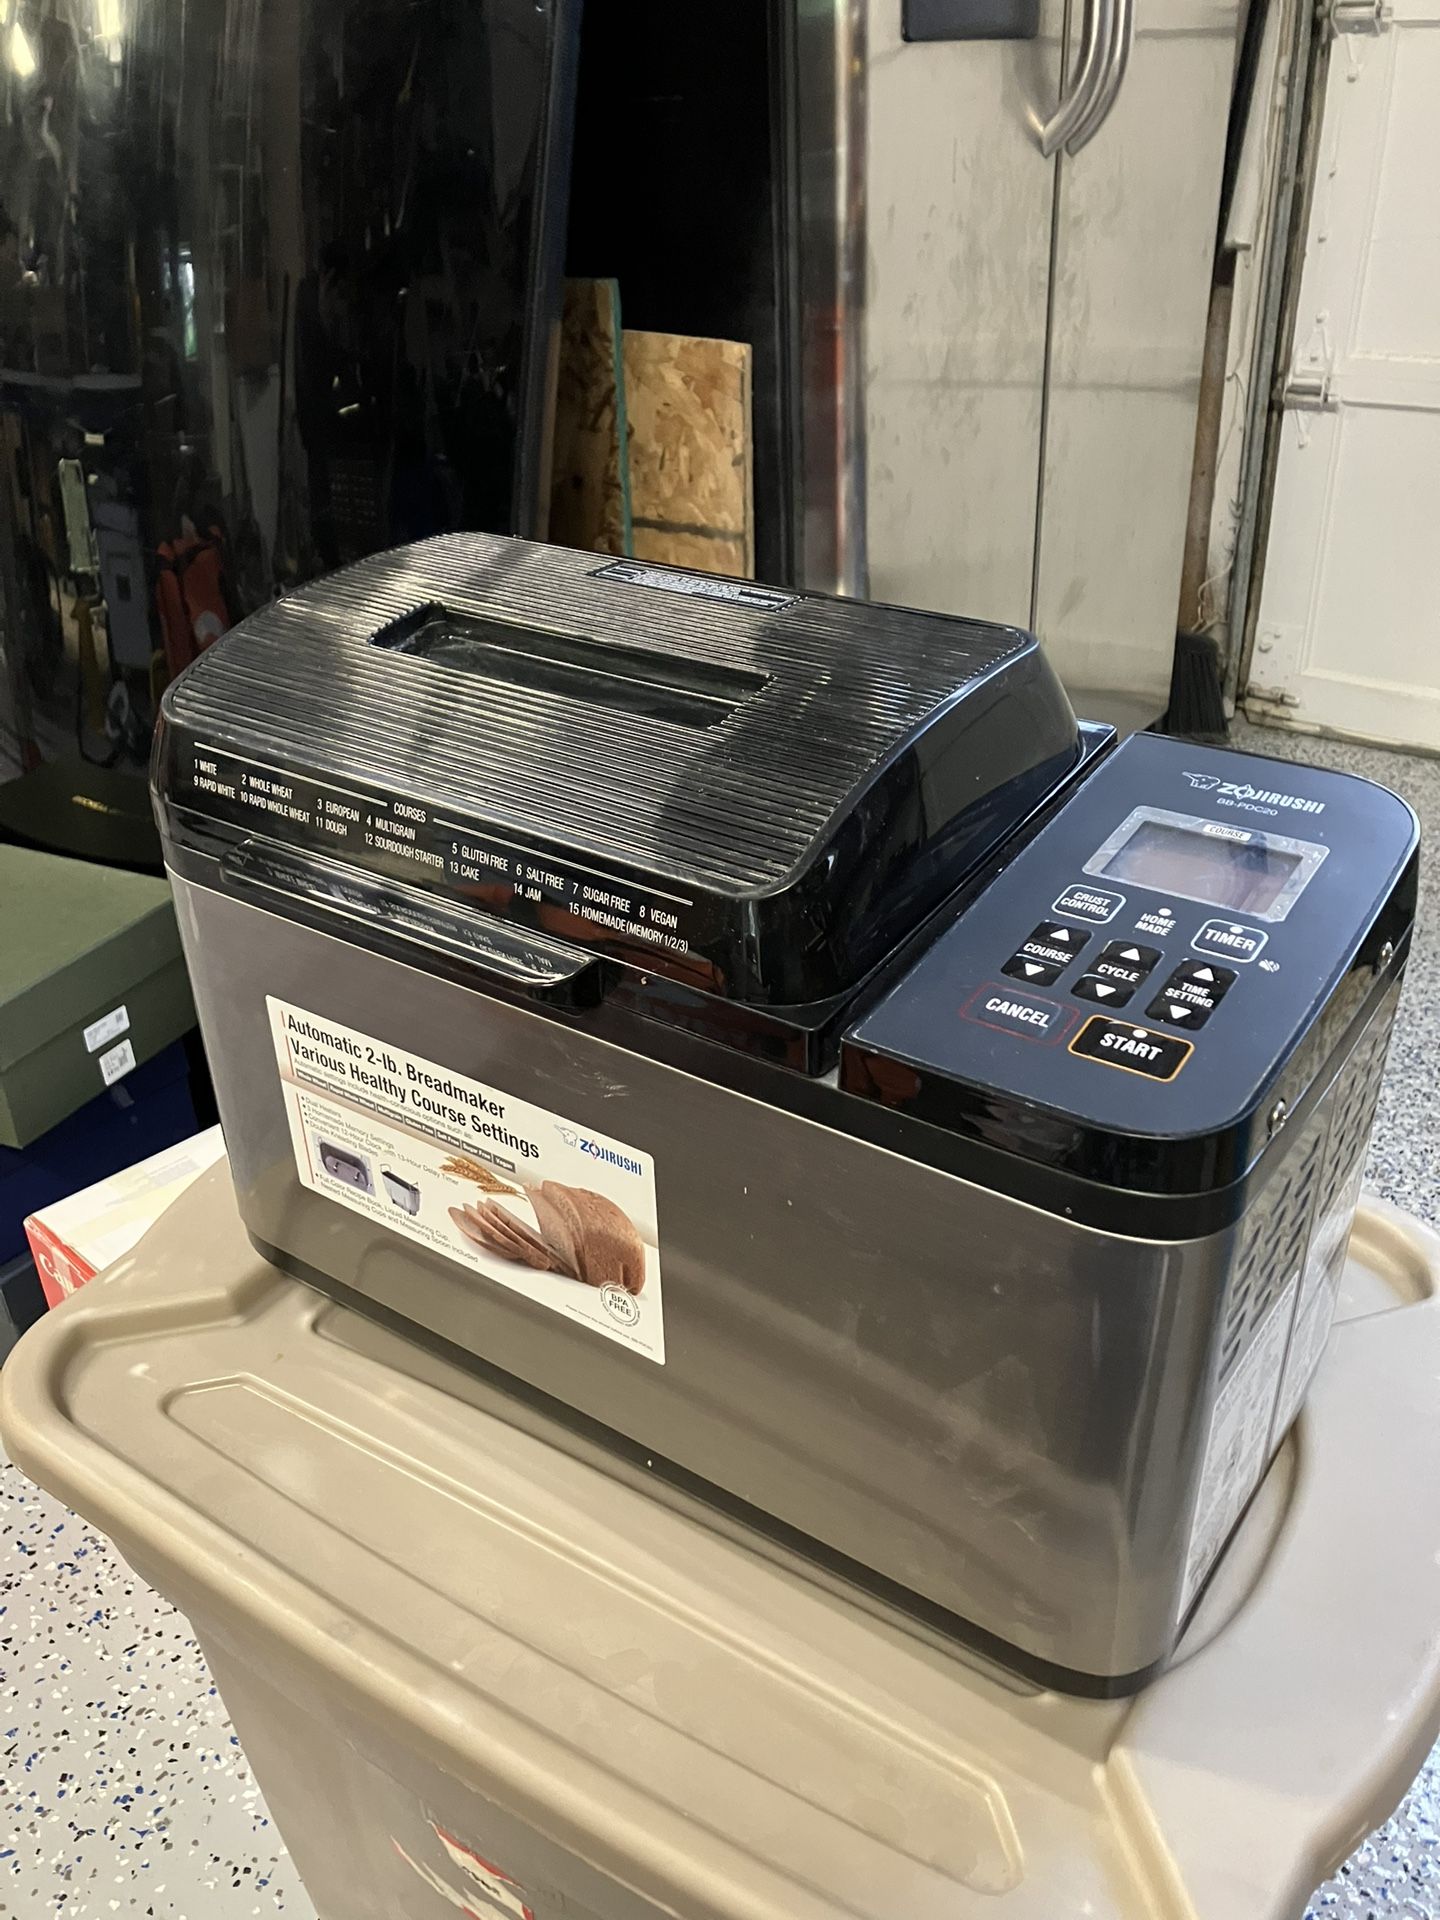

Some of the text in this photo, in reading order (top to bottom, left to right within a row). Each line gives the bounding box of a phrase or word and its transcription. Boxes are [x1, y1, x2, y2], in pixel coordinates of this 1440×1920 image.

[194, 758, 217, 776] 1 WHITE
[193, 774, 235, 799] 9 RAPID WHITE
[241, 772, 293, 800] 2 WHOLE WHEAT
[1217, 782, 1326, 814] ZOJIRUSHI
[240, 789, 310, 824] 10 RAPID WHOLE WHEAT
[316, 797, 359, 823] 3 EUROPEAN
[394, 803, 427, 824] COURSES
[315, 815, 347, 837] 11 DOUGH
[365, 813, 415, 841] 4 MULTIGRAIN
[1209, 826, 1245, 839] COURSE
[364, 831, 444, 869] 12 SOURDOUGH STARTER
[451, 841, 508, 872] 5 GLUTEN FREE
[449, 859, 480, 881] 13 CAKE
[515, 862, 564, 891] 6 SALT FREE
[513, 881, 542, 903] 14 JAM
[572, 881, 631, 914] 7 SUGAR FREE
[1073, 890, 1112, 907] CRUST
[638, 904, 678, 930] 8 VEGAN
[1061, 897, 1110, 917] CONTROL
[568, 900, 689, 955] 15 HOMEMADE (MEMORY 1/2/3)
[1135, 921, 1171, 936] MADE
[1140, 913, 1177, 929] HOME
[1204, 928, 1258, 952] TIMER
[1023, 942, 1074, 964] COURSE
[1097, 964, 1141, 983] CYCLE
[1165, 988, 1215, 1009] SETTING
[1181, 982, 1211, 998] TIME
[985, 998, 1051, 1029] CANCEL
[1100, 1033, 1164, 1061] START
[288, 1014, 506, 1119] Automatic 2-lb. Breadmaker
[290, 1038, 540, 1158] Various Healthy Course Settings
[579, 1138, 643, 1175] ZOJIRUSHI
[609, 1300, 632, 1317] FREE
[611, 1293, 629, 1308] BPA
